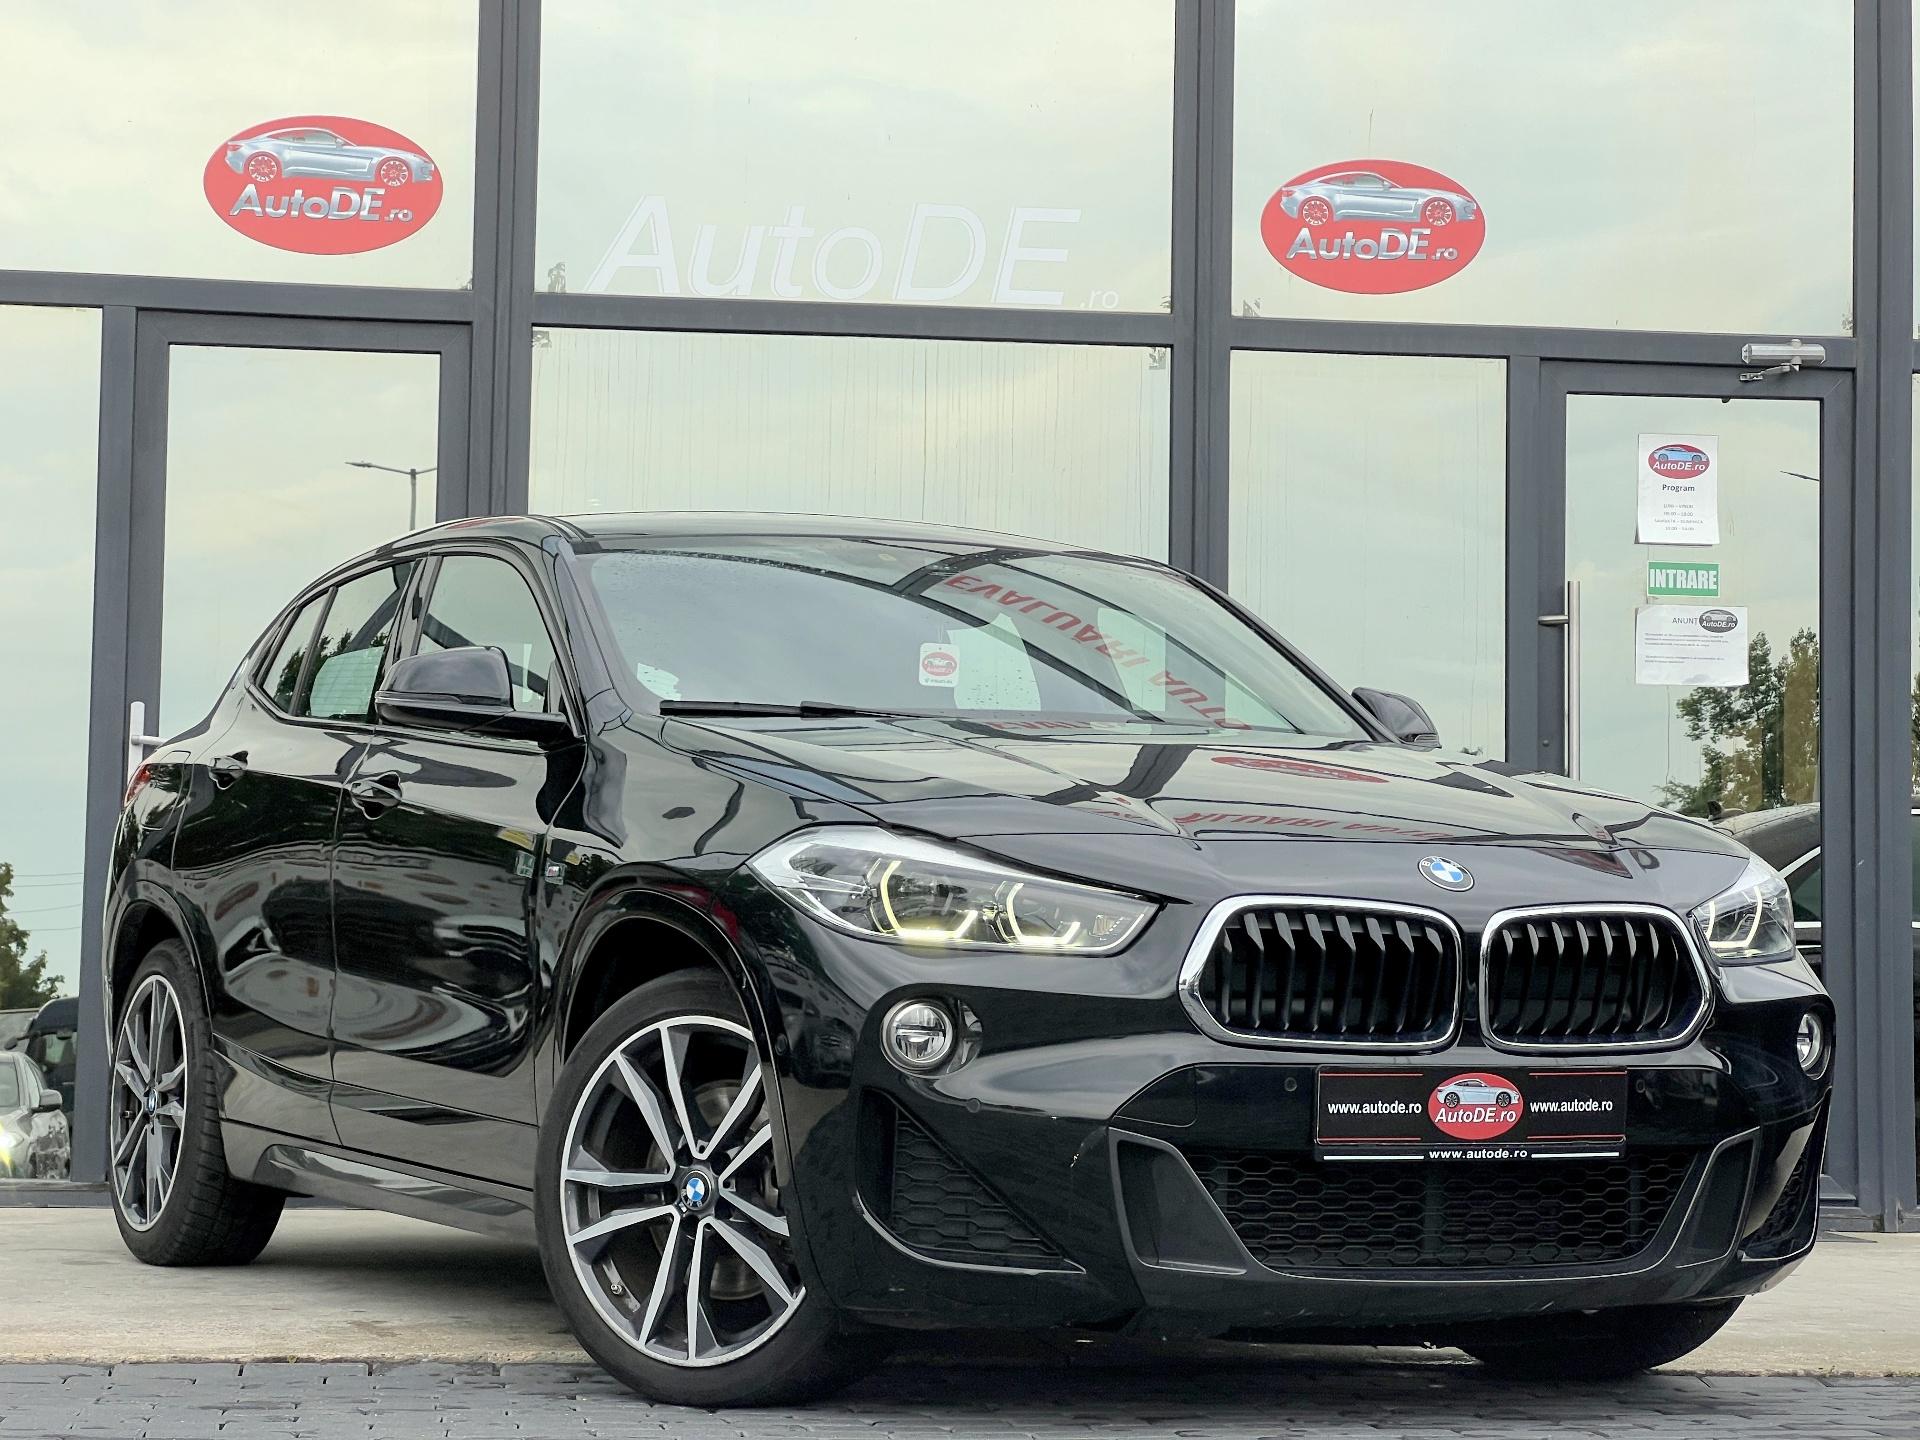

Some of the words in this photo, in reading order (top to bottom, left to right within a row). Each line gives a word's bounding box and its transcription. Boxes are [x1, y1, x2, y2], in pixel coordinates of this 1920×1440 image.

[1652, 461, 1705, 471] AutoDE.ro
[1662, 483, 1695, 493] Program
[1649, 570, 1717, 589] INTRARE
[1701, 620, 1736, 628] AutoDE.ro
[1327, 1101, 1422, 1115] www.autode.ro
[1434, 1107, 1516, 1123] AutoDE.ro
[1529, 1099, 1613, 1113] www.autode.ro
[1429, 1149, 1529, 1159] www.autode.ro
